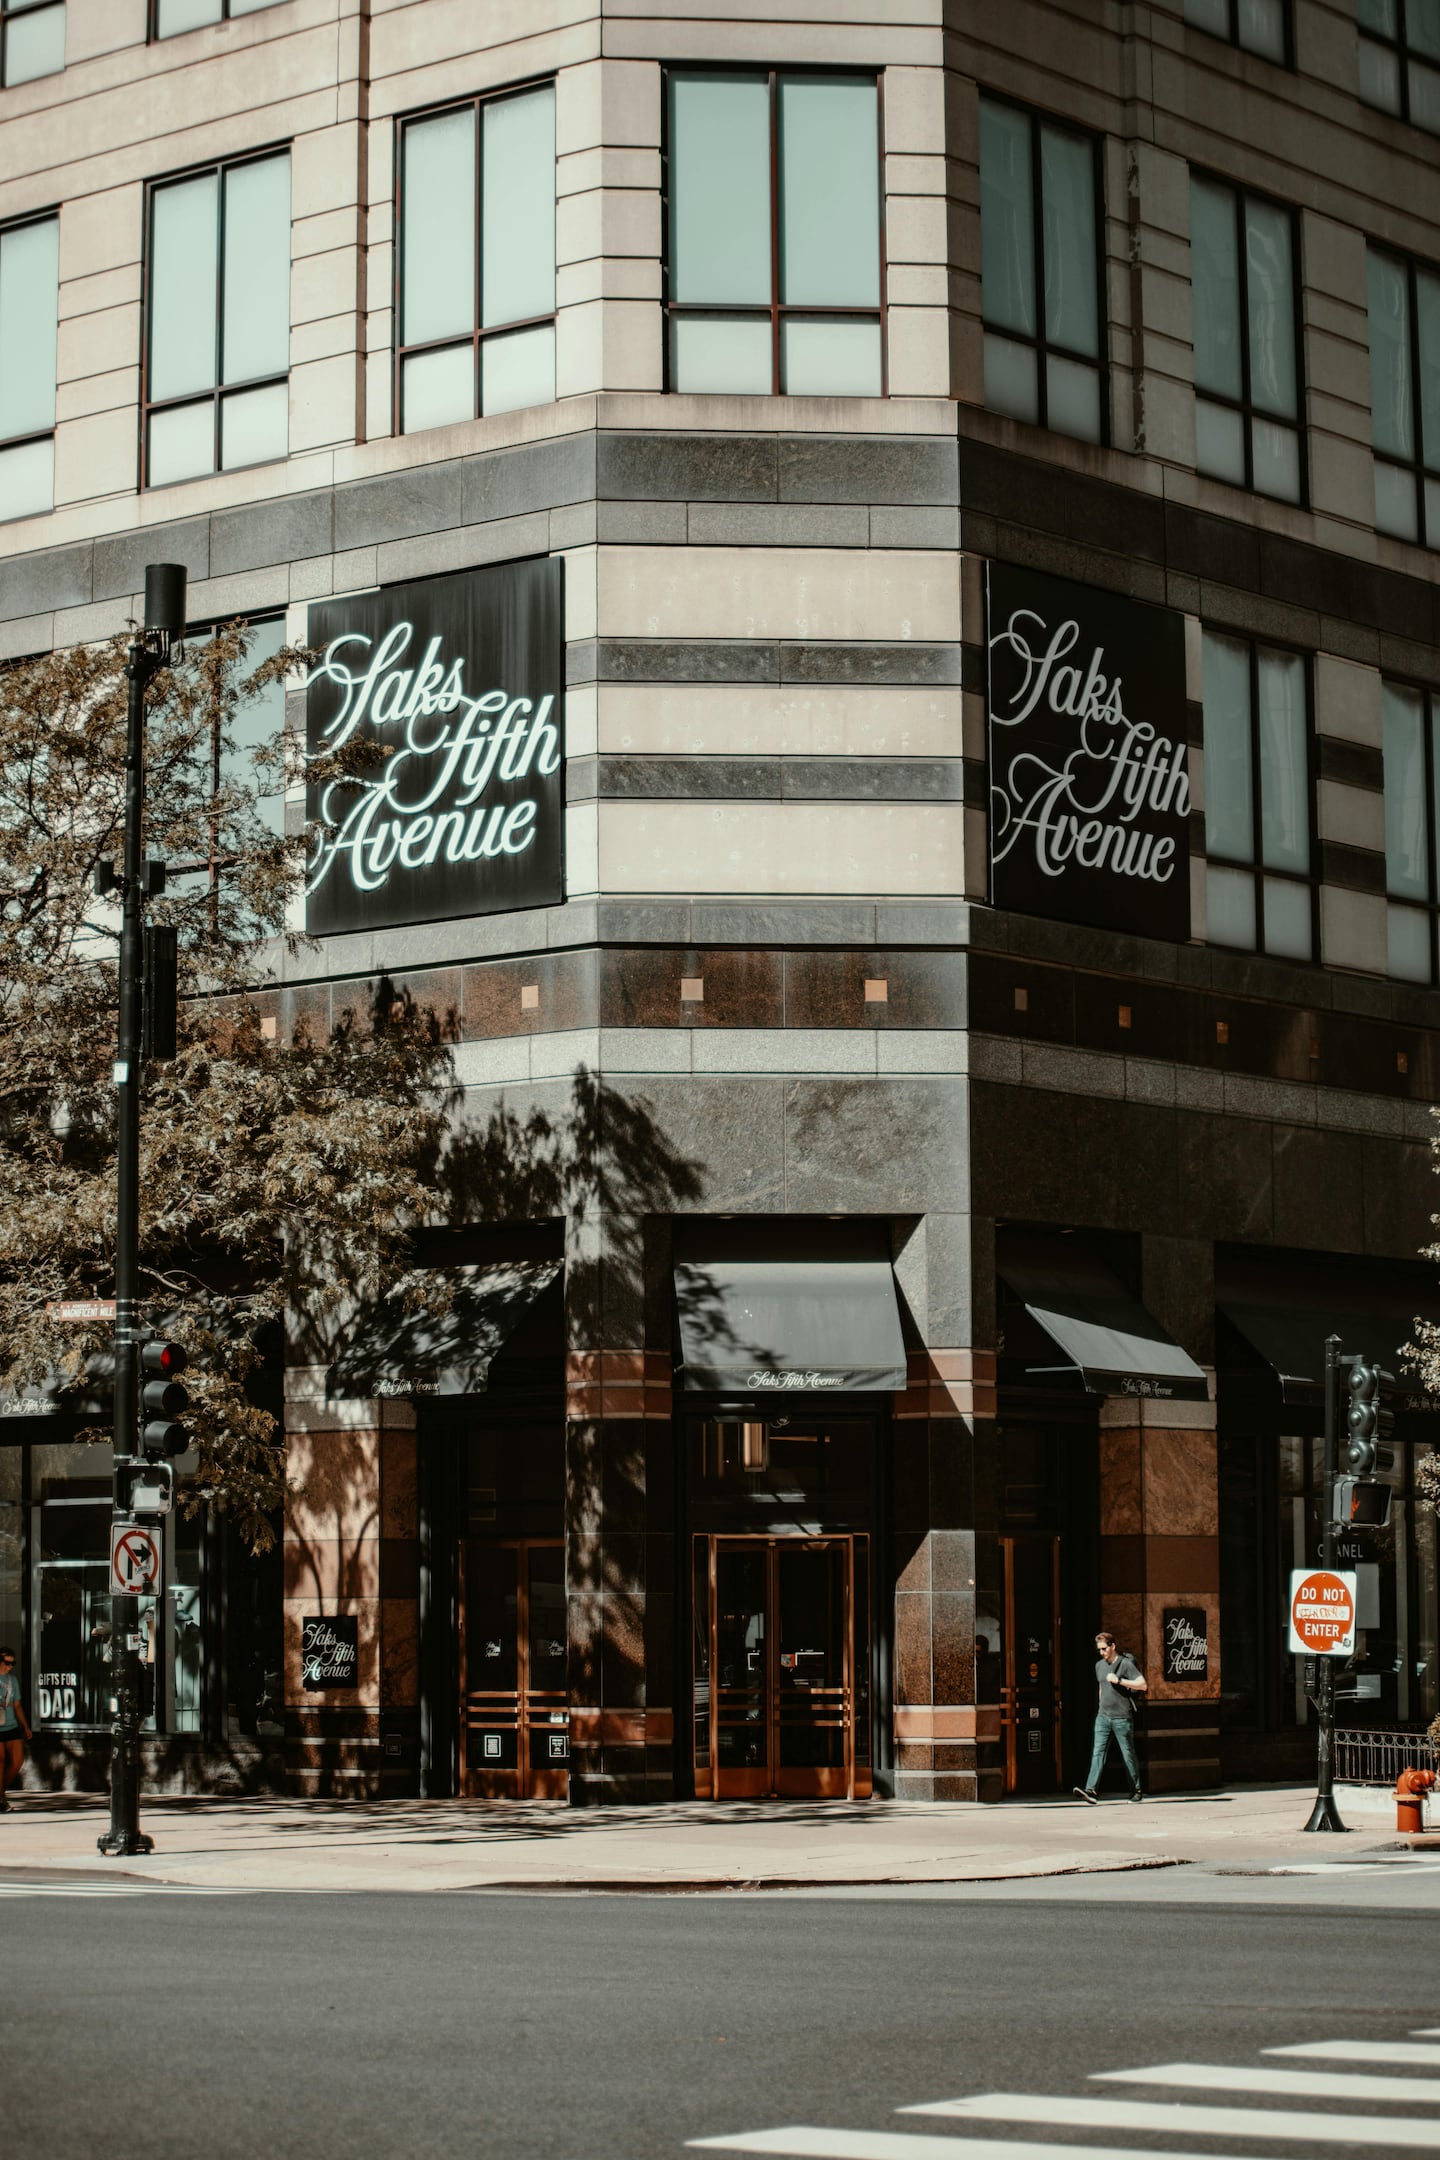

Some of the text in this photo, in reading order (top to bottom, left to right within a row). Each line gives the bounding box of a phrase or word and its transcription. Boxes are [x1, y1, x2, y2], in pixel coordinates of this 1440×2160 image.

[990, 609, 1123, 726] Saks
[304, 621, 464, 759] Saks
[385, 690, 562, 815] Fifth
[1064, 704, 1192, 822] Fifth
[992, 753, 1176, 883] Avenue
[304, 775, 537, 892] Avenue
[100, 1306, 114, 1317] MILE
[371, 1376, 440, 1396] Saks Fifth Avenue
[747, 1371, 845, 1389] Saks Fifth Avenue
[1301, 1587, 1346, 1602] DO NOT
[301, 1623, 337, 1651] Saks
[1166, 1617, 1194, 1645] Saks
[1304, 1623, 1340, 1638] ENTER
[319, 1641, 356, 1666] Fifth
[1167, 1648, 1206, 1674] Avenue
[1180, 1636, 1209, 1660] Fifth
[38, 1672, 77, 1687] GIFTS FOR
[301, 1654, 351, 1681] Avenue
[39, 1688, 76, 1719] DAD
